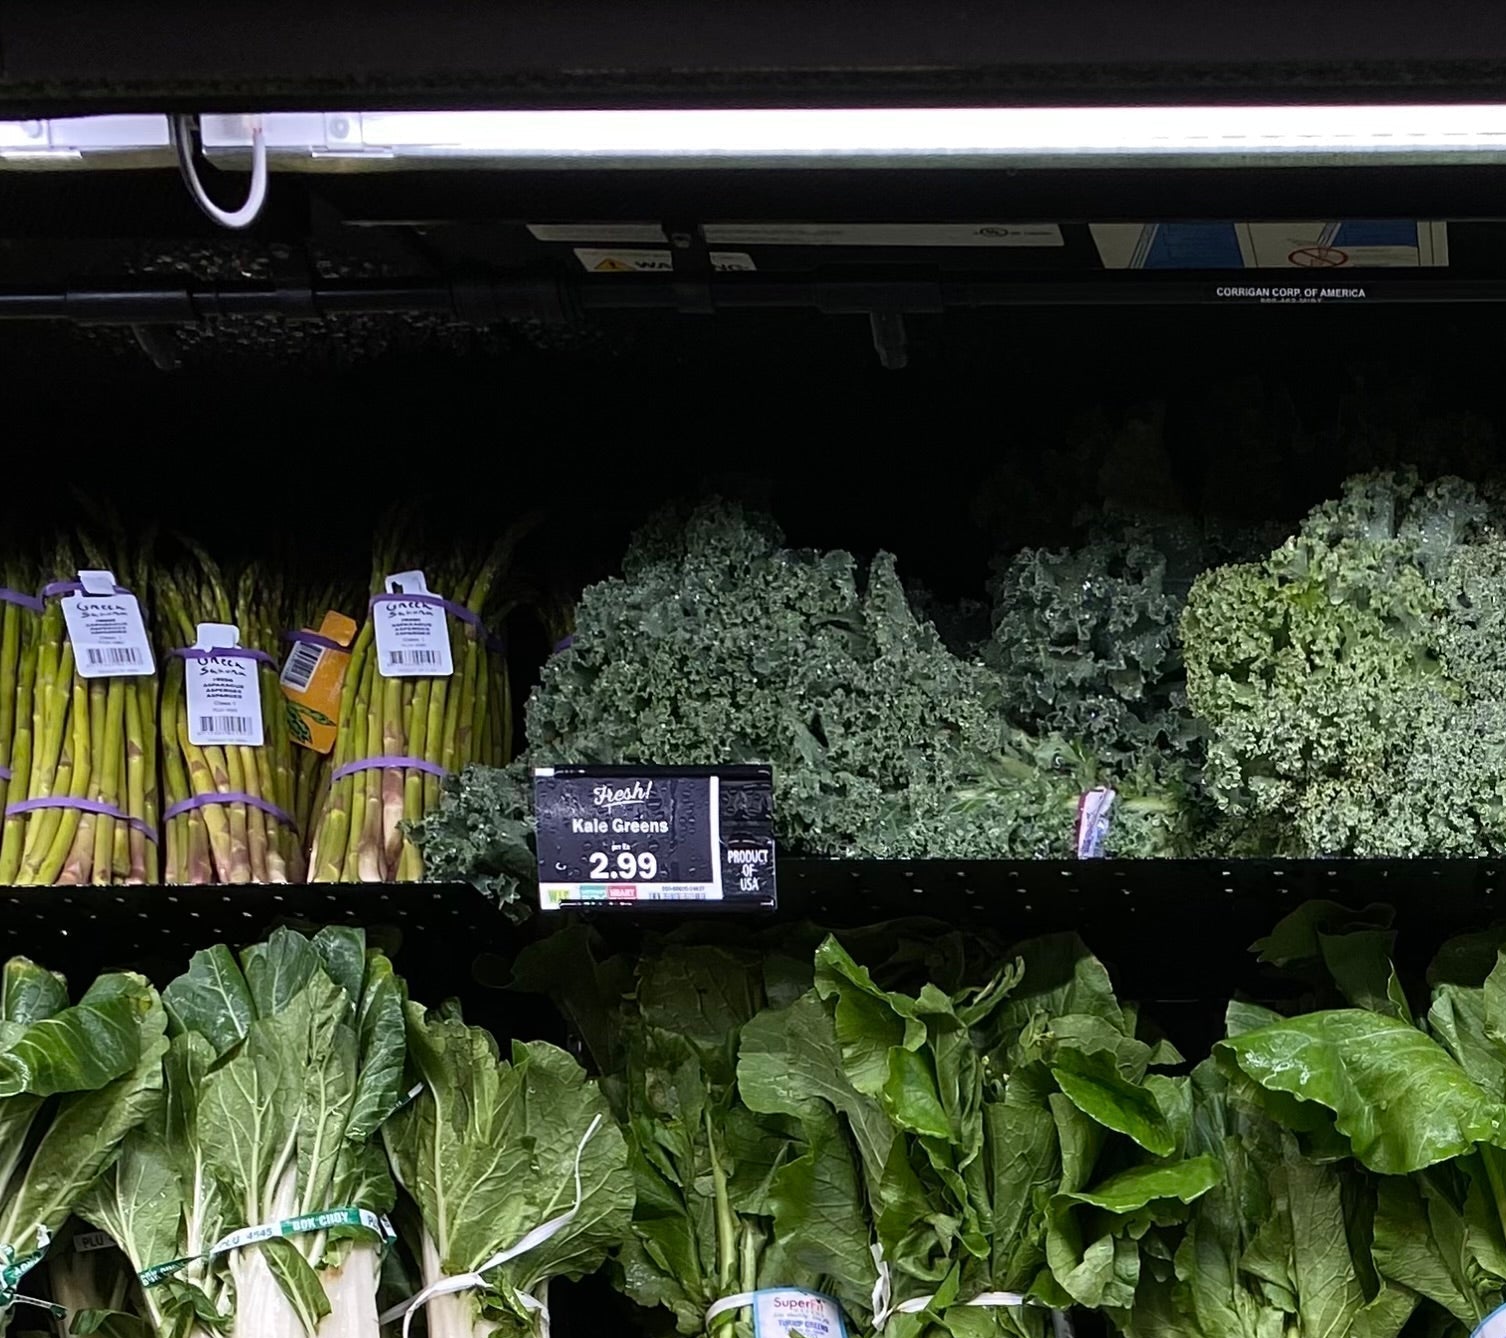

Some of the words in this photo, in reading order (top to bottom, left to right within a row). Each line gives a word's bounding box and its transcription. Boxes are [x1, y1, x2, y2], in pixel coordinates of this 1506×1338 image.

[1216, 287, 1269, 297] CORRIGAN
[1272, 287, 1302, 297] CORP.
[1304, 288, 1318, 297] OF
[1320, 288, 1366, 298] AMERICA
[593, 781, 652, 805] Fresh!
[572, 819, 609, 833] Kale
[612, 819, 669, 833] Greens
[728, 850, 768, 864] PRODUCT
[589, 852, 657, 879] 2.99
[743, 864, 755, 877] OF
[740, 878, 760, 891] USA
